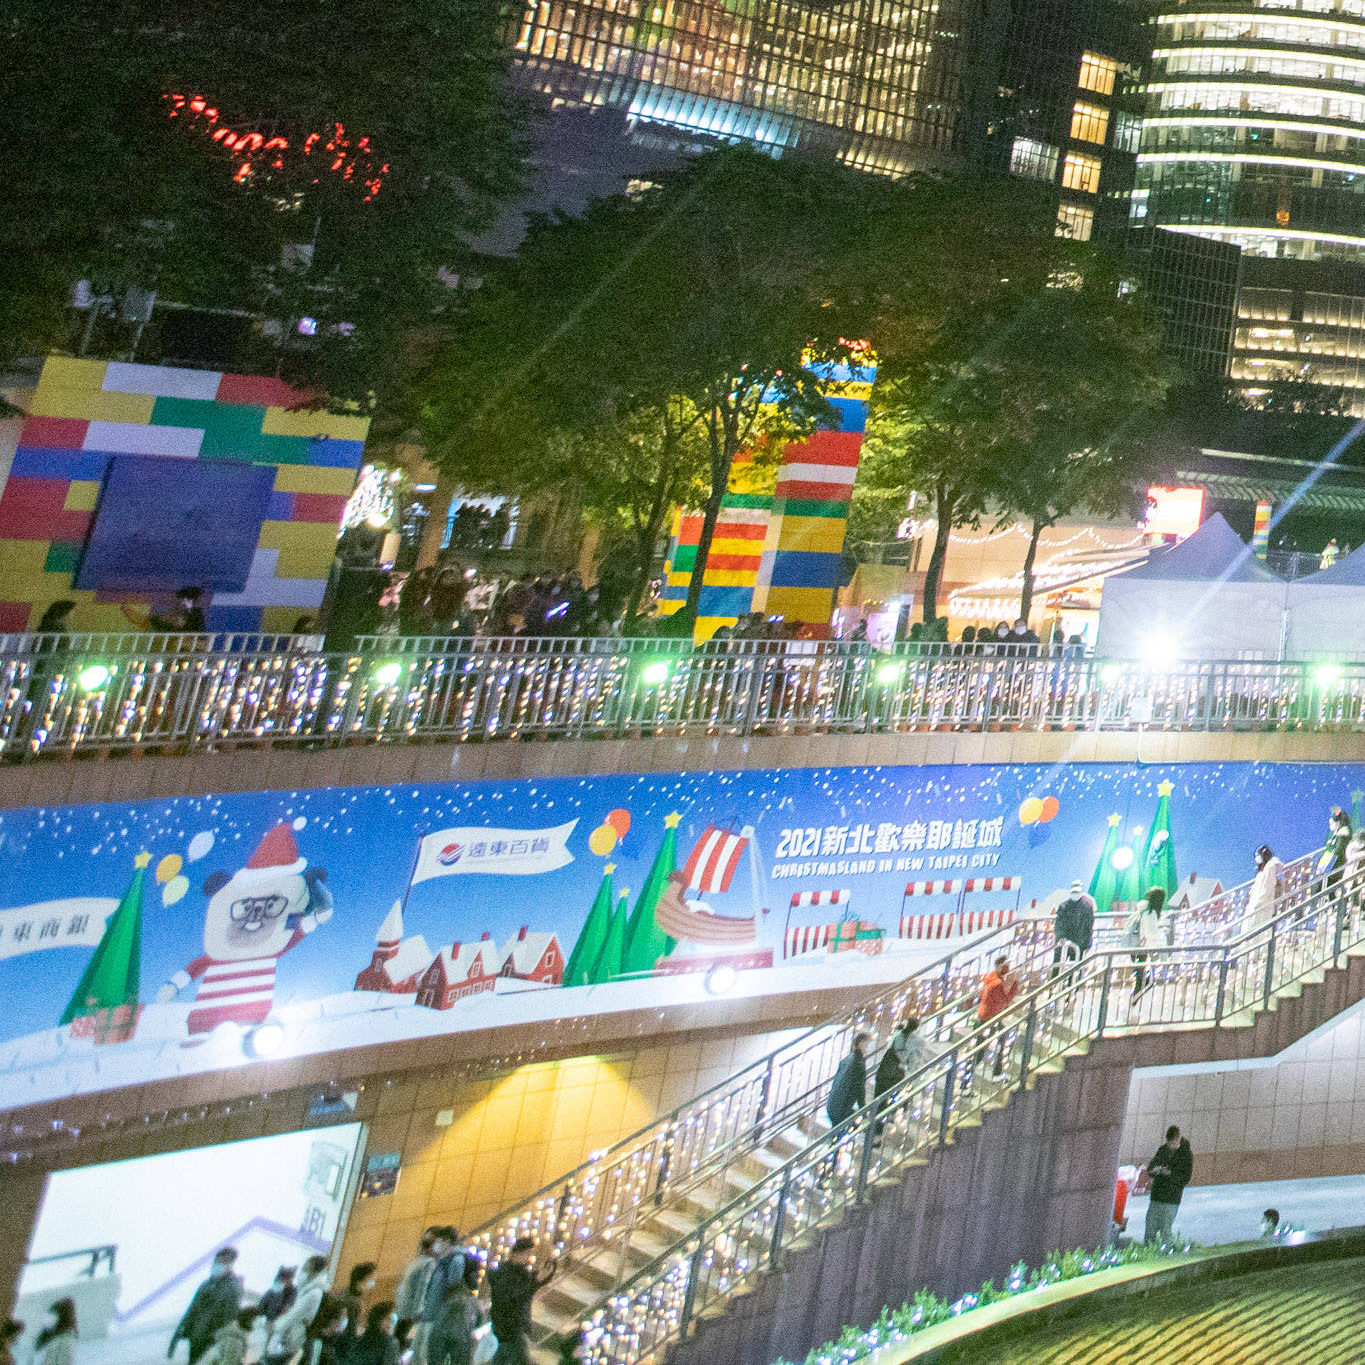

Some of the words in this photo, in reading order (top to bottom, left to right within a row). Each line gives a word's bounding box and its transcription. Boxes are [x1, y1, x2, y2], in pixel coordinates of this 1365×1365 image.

[467, 837, 551, 858] 遠東百貨
[775, 815, 1004, 859] 2021新北歡樂耶誕城
[771, 859, 877, 879] CHRISTMASLAND
[878, 859, 893, 873] IN
[896, 857, 925, 871] NEW
[927, 854, 969, 870] TAIPEI
[971, 853, 1001, 867] CITY
